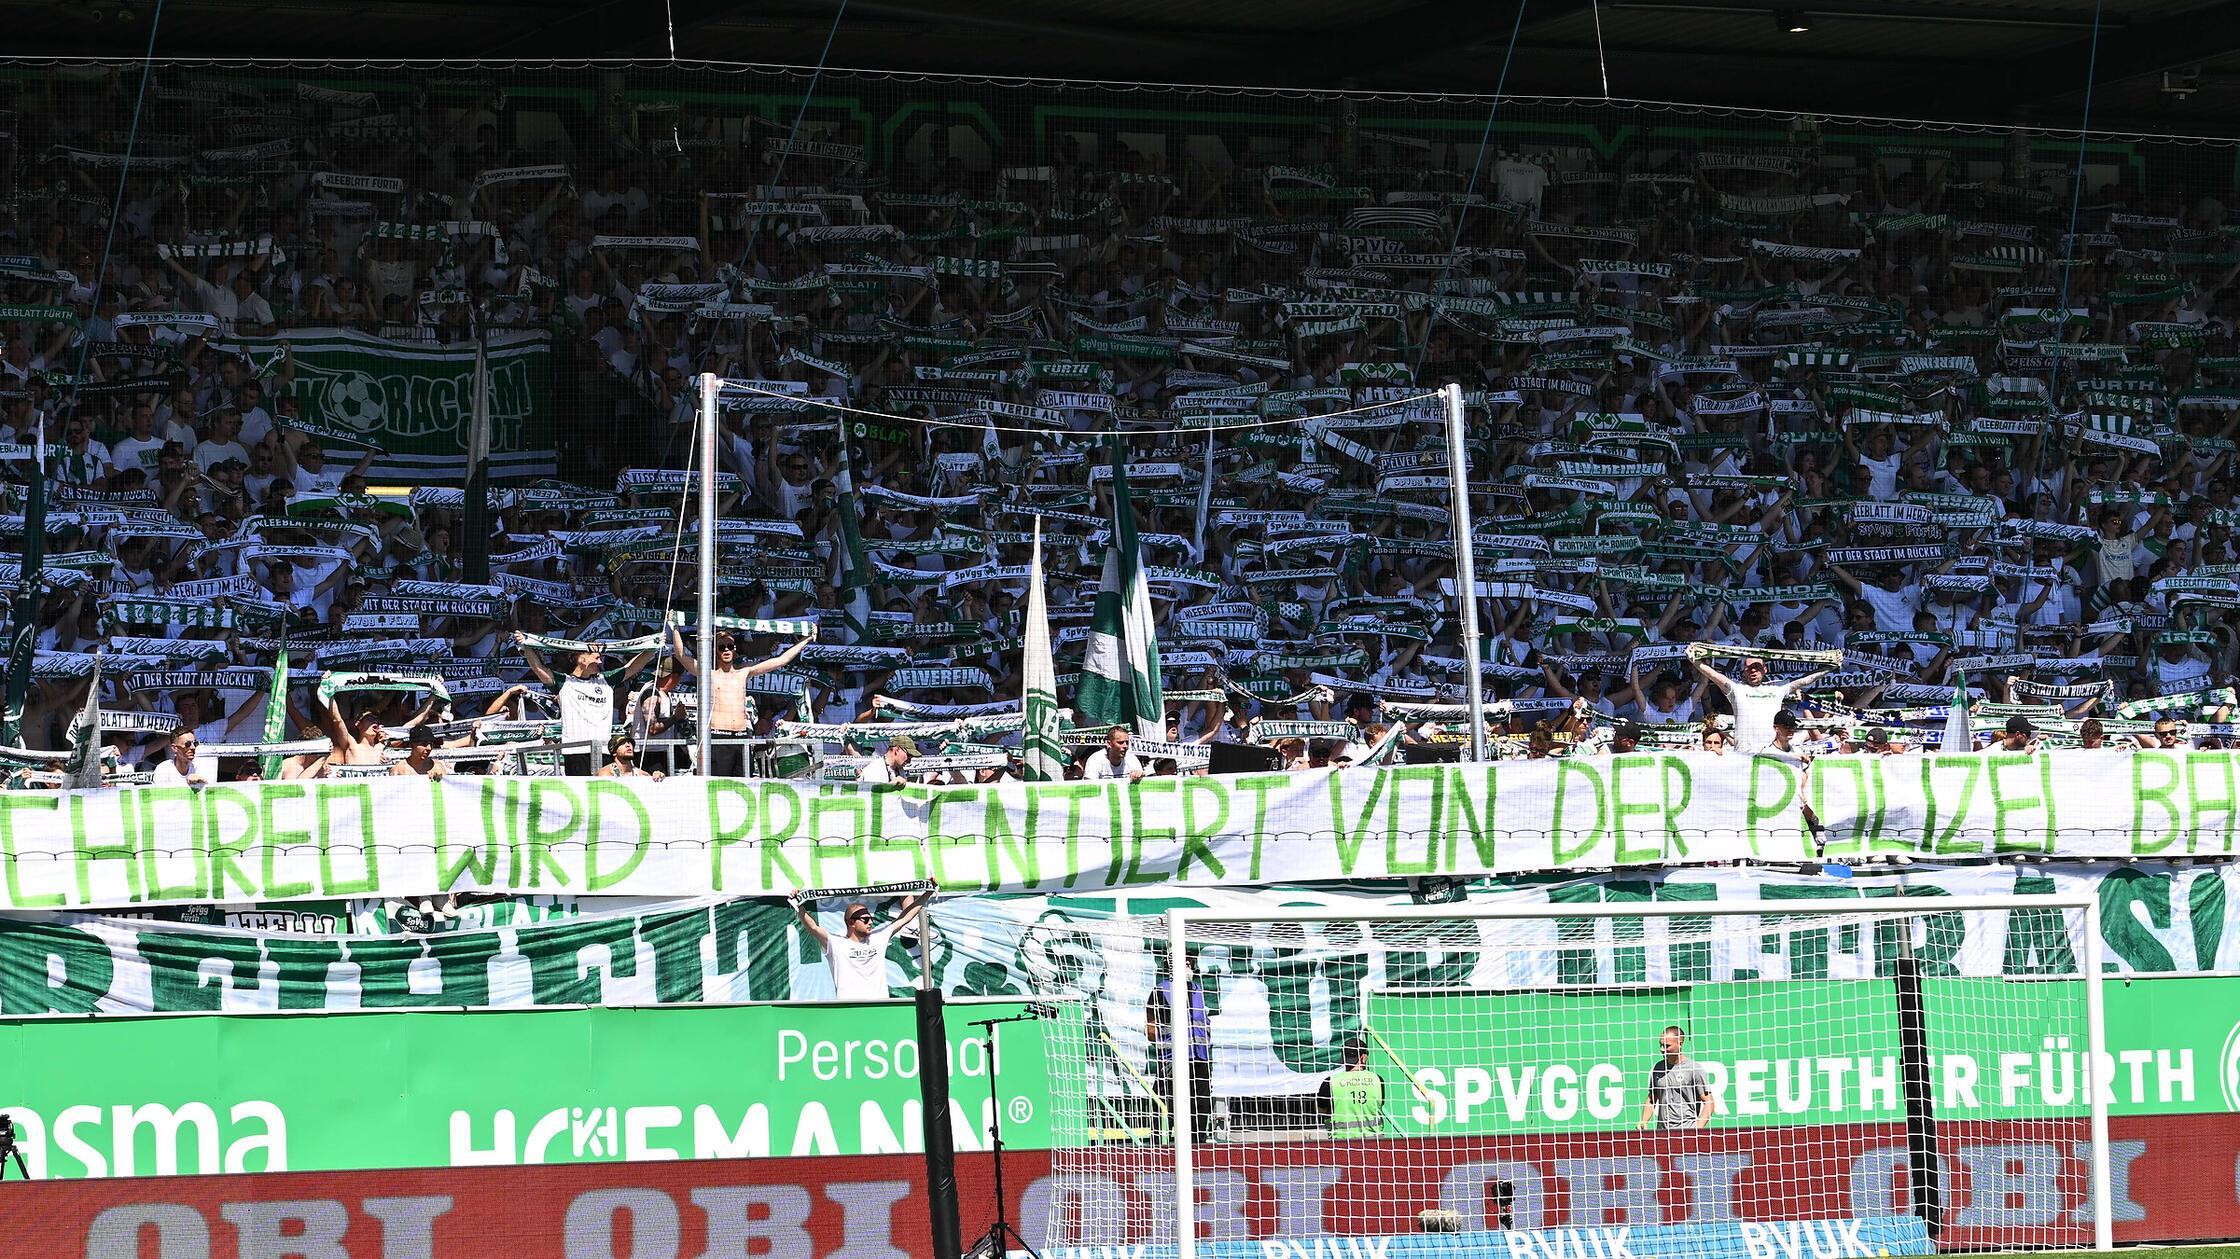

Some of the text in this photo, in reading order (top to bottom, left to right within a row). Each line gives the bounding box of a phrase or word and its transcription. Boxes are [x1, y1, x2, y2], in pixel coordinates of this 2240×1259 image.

[944, 371, 996, 380] KLEEBLATT
[2076, 379, 2154, 390] FÜRTH
[999, 404, 1037, 418] VERDE
[643, 509, 670, 518] Fürth
[1232, 513, 1300, 523] SpVgg Fürth
[1270, 522, 1347, 532] SpVgg Fürth
[1513, 538, 1543, 549] FÜRTH
[1611, 538, 1638, 548] RONHOF
[1907, 546, 1942, 557] RÜCKEN
[955, 569, 982, 580] SpVgg
[1859, 632, 1929, 641] SpVgg Fürth
[122, 639, 218, 659] Kleeblatt
[143, 673, 254, 687] DER STADT IM RÜCKEN
[133, 716, 145, 729] IM
[1, 752, 2240, 907] CHOREO WIRD PRÄSENTIERT VON DER POLIZEI BA
[778, 1023, 1001, 1081] Persoal
[1412, 1066, 1623, 1124] SPVGG
[1657, 1053, 1978, 1115] REUTHR
[1350, 1090, 1367, 1105] 18
[1850, 1139, 2147, 1228] OBI
[1441, 1152, 1754, 1234] OBI
[1020, 1167, 1341, 1249] OBI
[86, 1196, 455, 1259] OBI
[564, 1182, 912, 1259] OBI
[1740, 1219, 1877, 1259] BVUK
